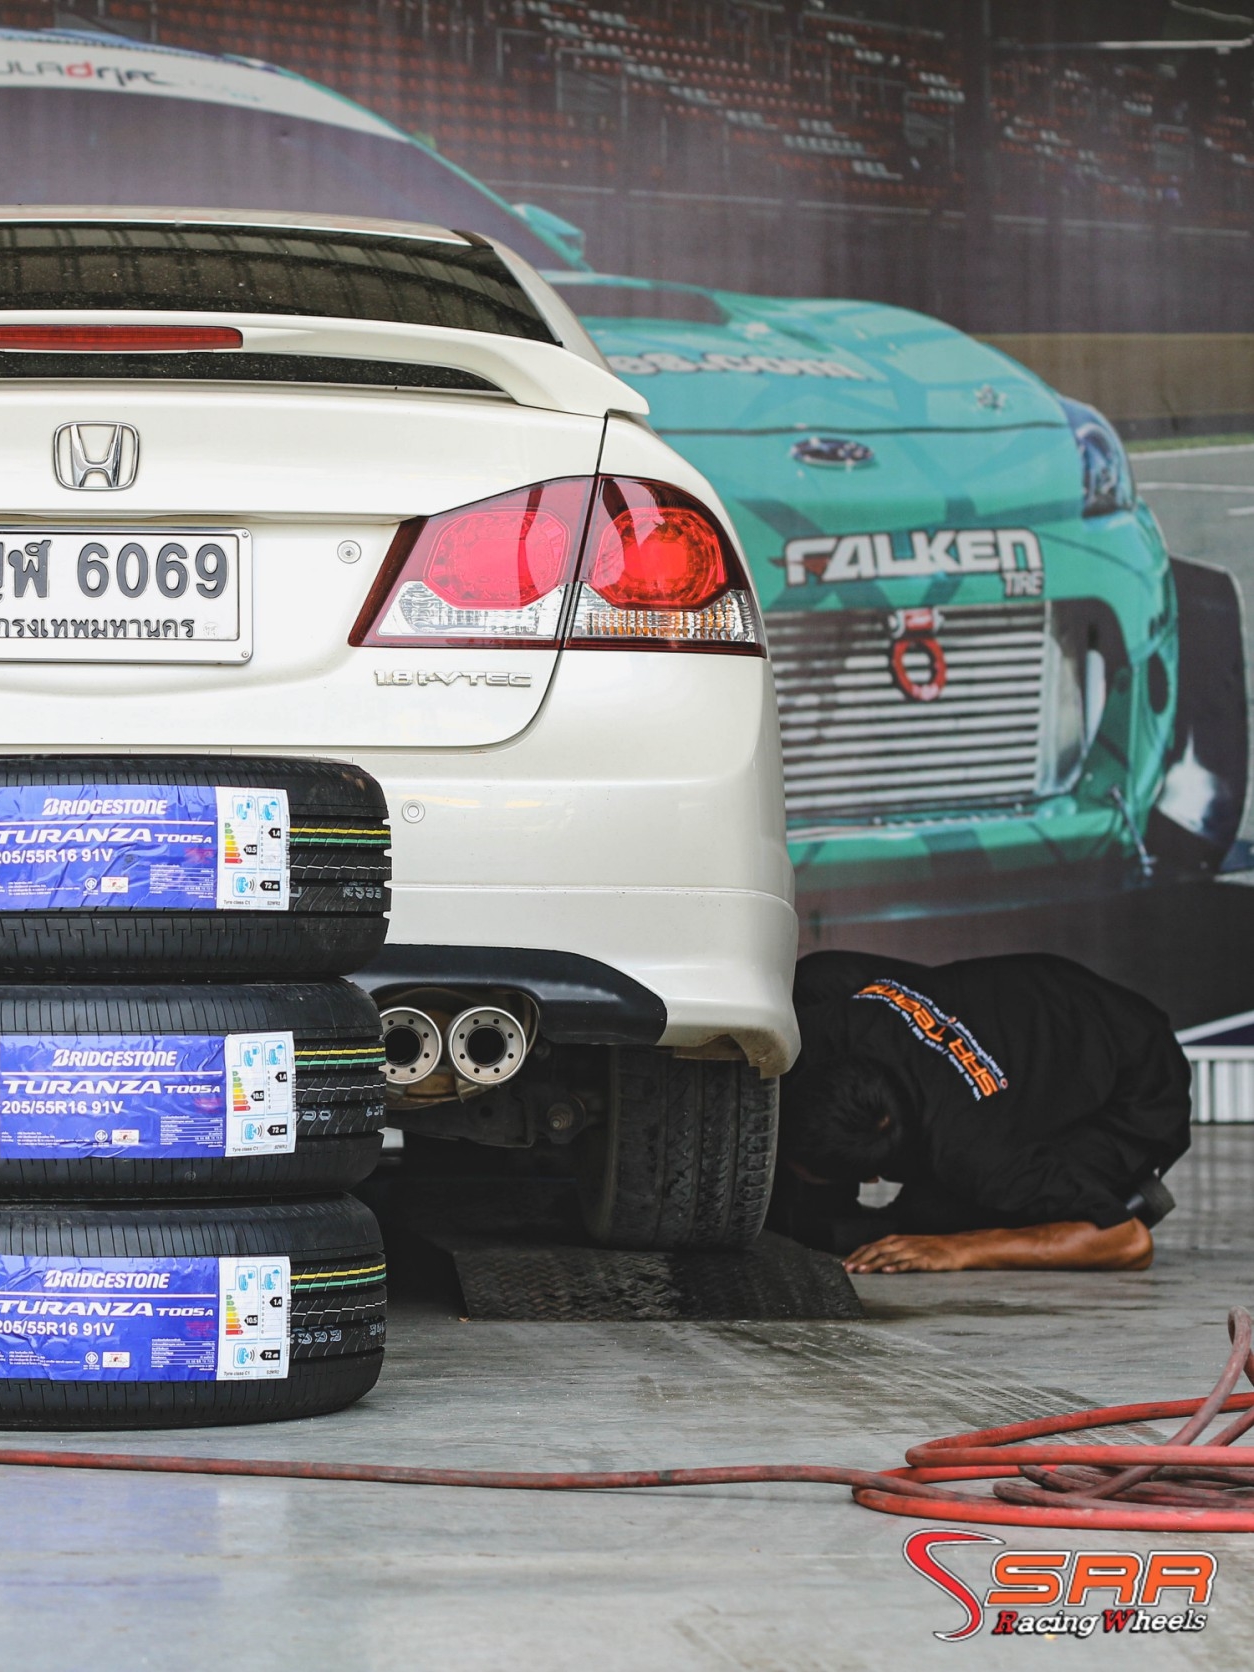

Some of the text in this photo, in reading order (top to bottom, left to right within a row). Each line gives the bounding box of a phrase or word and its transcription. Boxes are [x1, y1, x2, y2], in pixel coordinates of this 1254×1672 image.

[785, 528, 1043, 586] FALKEN
[77, 542, 229, 599] 6069
[1003, 572, 1044, 597] TIRE
[41, 797, 167, 815] BRIDGESTONE
[81, 848, 113, 862] 91V
[52, 1048, 177, 1067] BRIDGESTONE
[948, 1037, 999, 1096] SRR
[2, 1080, 162, 1095] TURANZA
[1, 1100, 123, 1115] 205/55R16 91V
[44, 1270, 170, 1289] BRIDGESTONE
[82, 1322, 115, 1336] 91V
